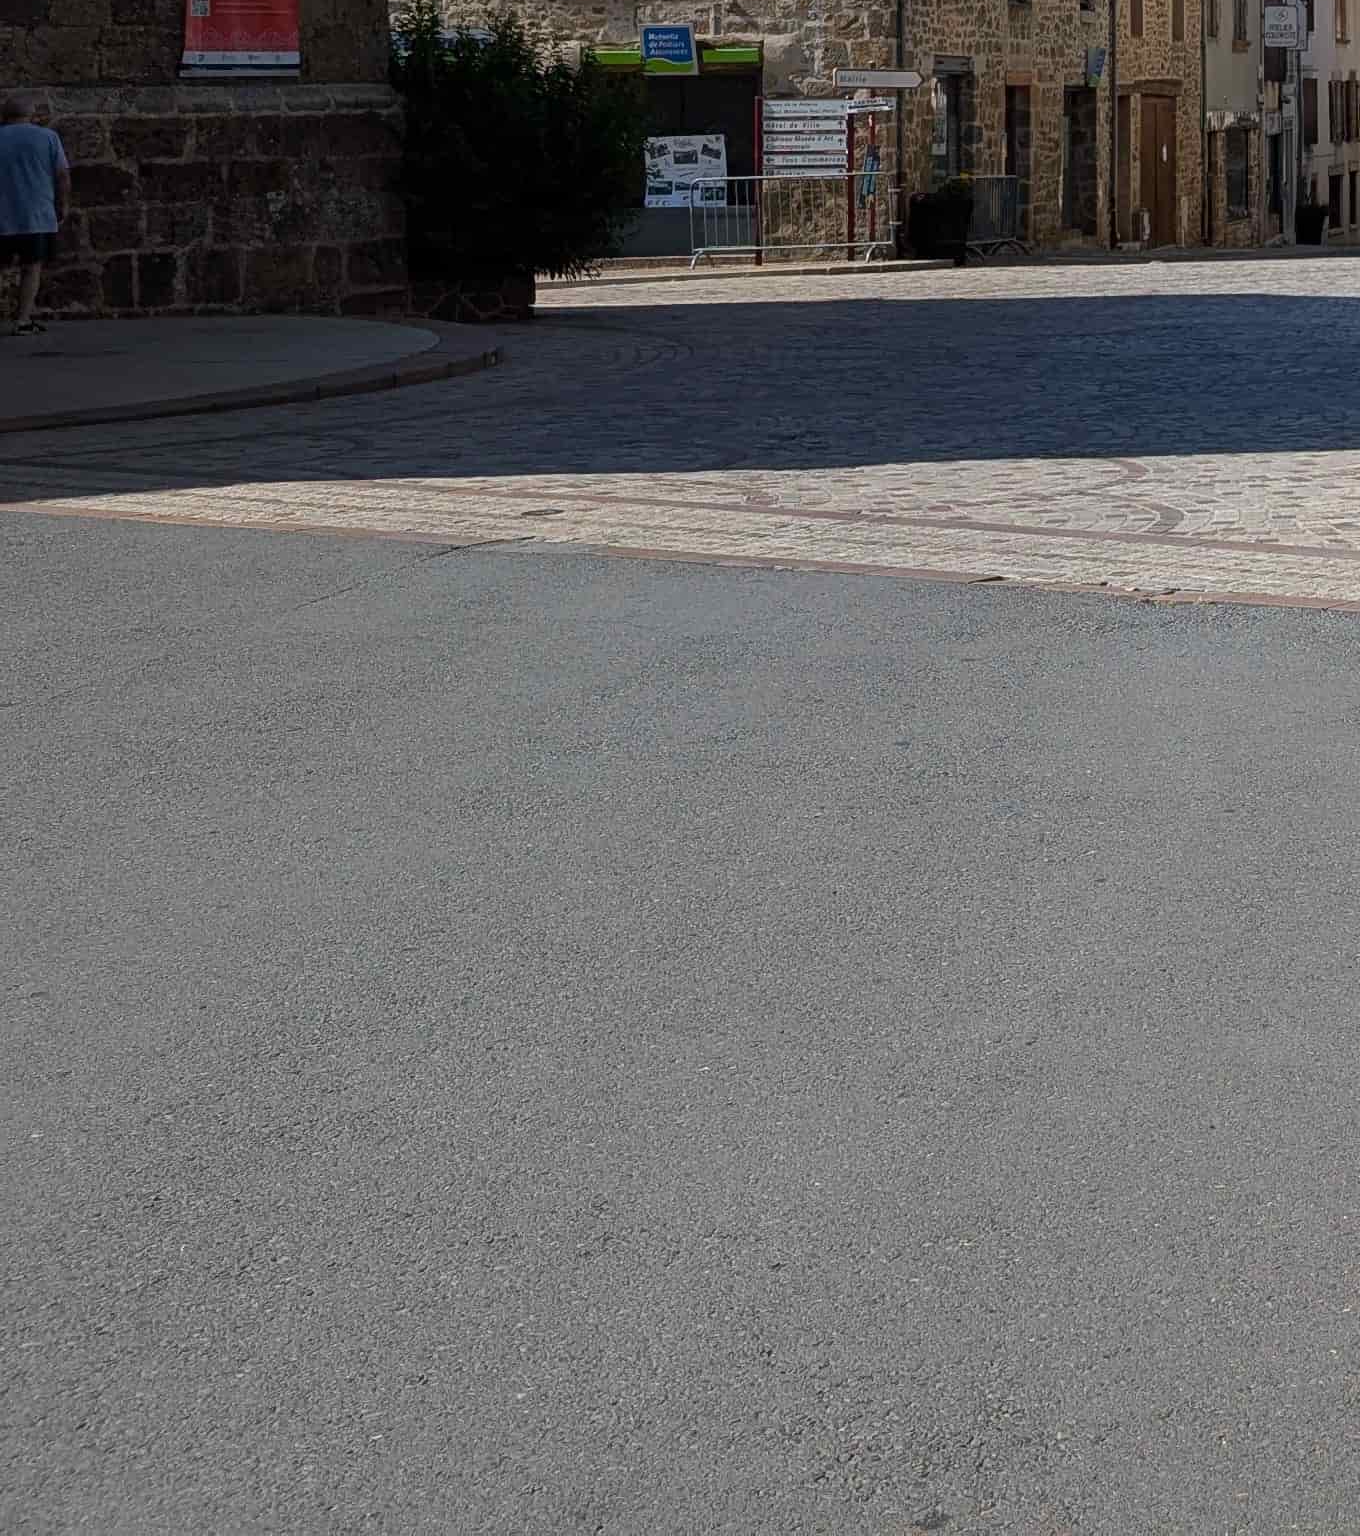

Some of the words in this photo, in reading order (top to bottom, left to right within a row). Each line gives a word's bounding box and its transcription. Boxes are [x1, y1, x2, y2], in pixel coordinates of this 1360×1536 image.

[839, 73, 867, 84] Mairie
[765, 120, 788, 129] Hôtel
[802, 120, 821, 129] Ville
